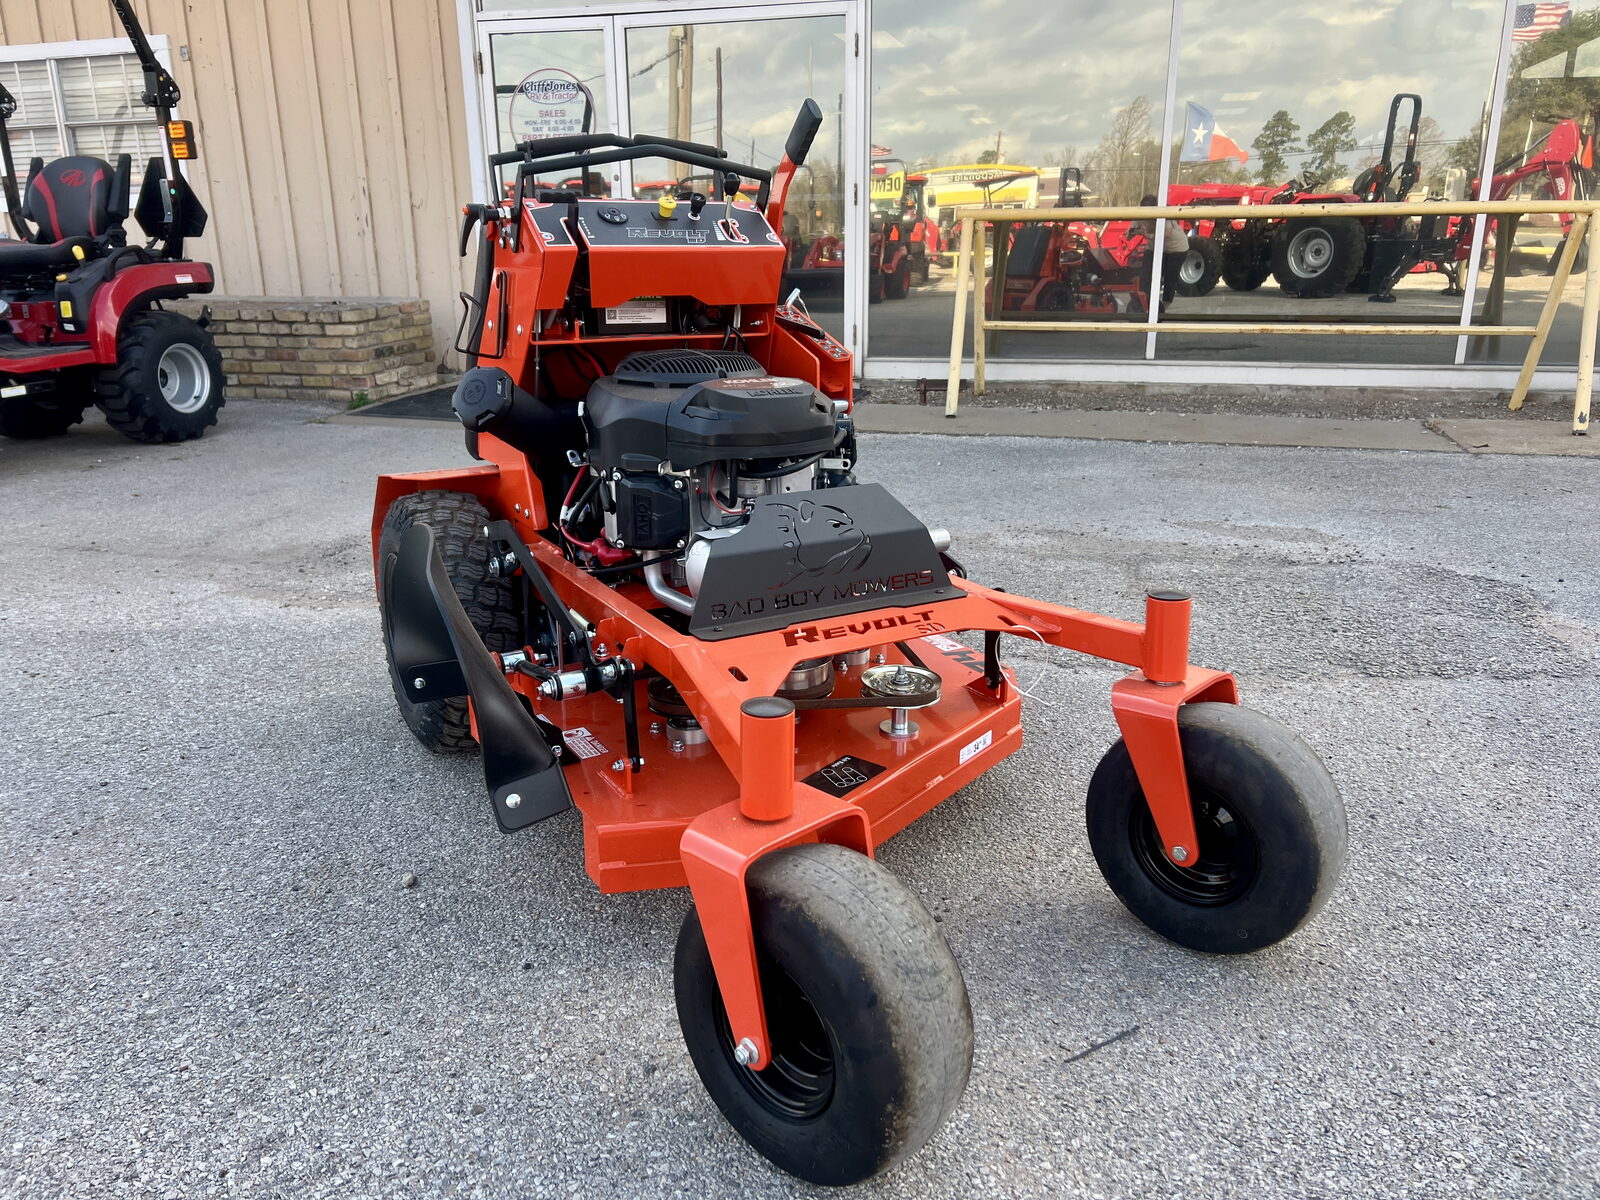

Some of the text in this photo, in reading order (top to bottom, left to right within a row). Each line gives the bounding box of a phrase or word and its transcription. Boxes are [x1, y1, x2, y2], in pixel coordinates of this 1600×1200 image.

[524, 81, 577, 93] Cliff Jones
[542, 92, 549, 100] &
[551, 91, 577, 100] Tractor
[538, 109, 566, 118] SALES
[626, 227, 710, 239] REVOLT
[746, 387, 804, 398] KOHLER
[711, 568, 935, 621] BAD BOY MOWERS
[780, 610, 934, 647] REVOLT
